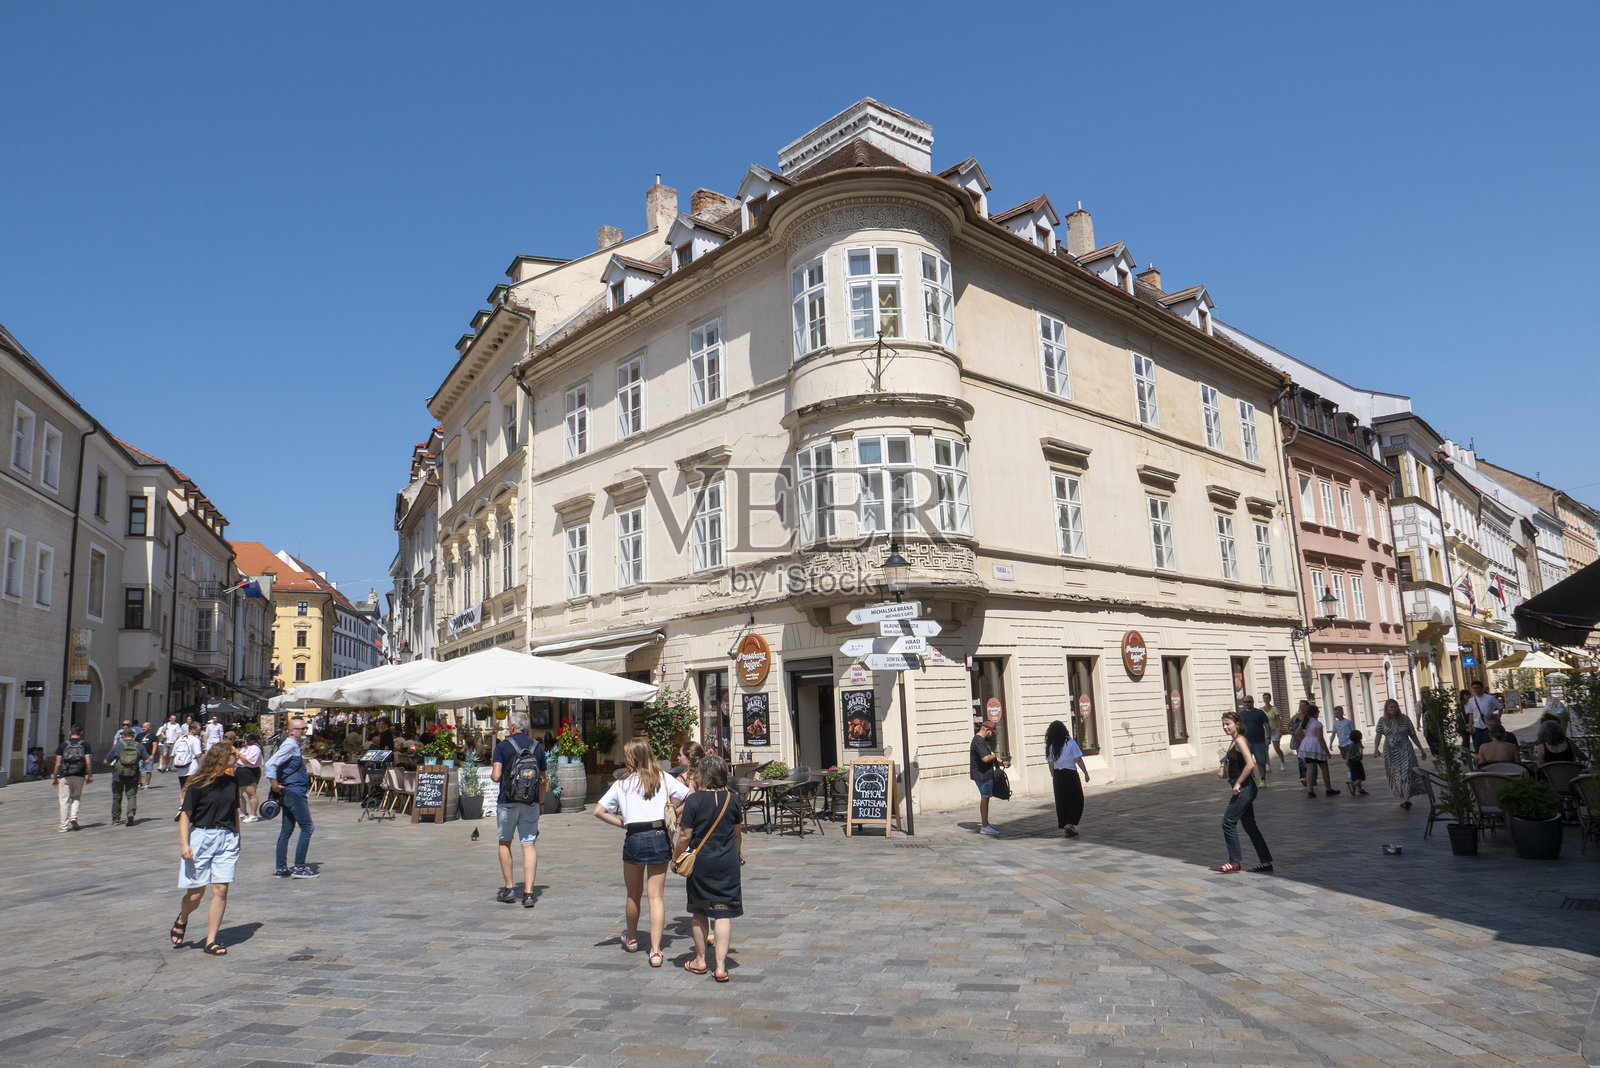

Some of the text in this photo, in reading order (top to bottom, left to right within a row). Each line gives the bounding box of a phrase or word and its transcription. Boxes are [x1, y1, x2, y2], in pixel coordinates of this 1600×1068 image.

[871, 607, 896, 615] MICHALSKÁ
[860, 790, 885, 798] TYPICAL
[852, 799, 887, 808] BRATISLAVA
[858, 807, 882, 818] ROLLS
